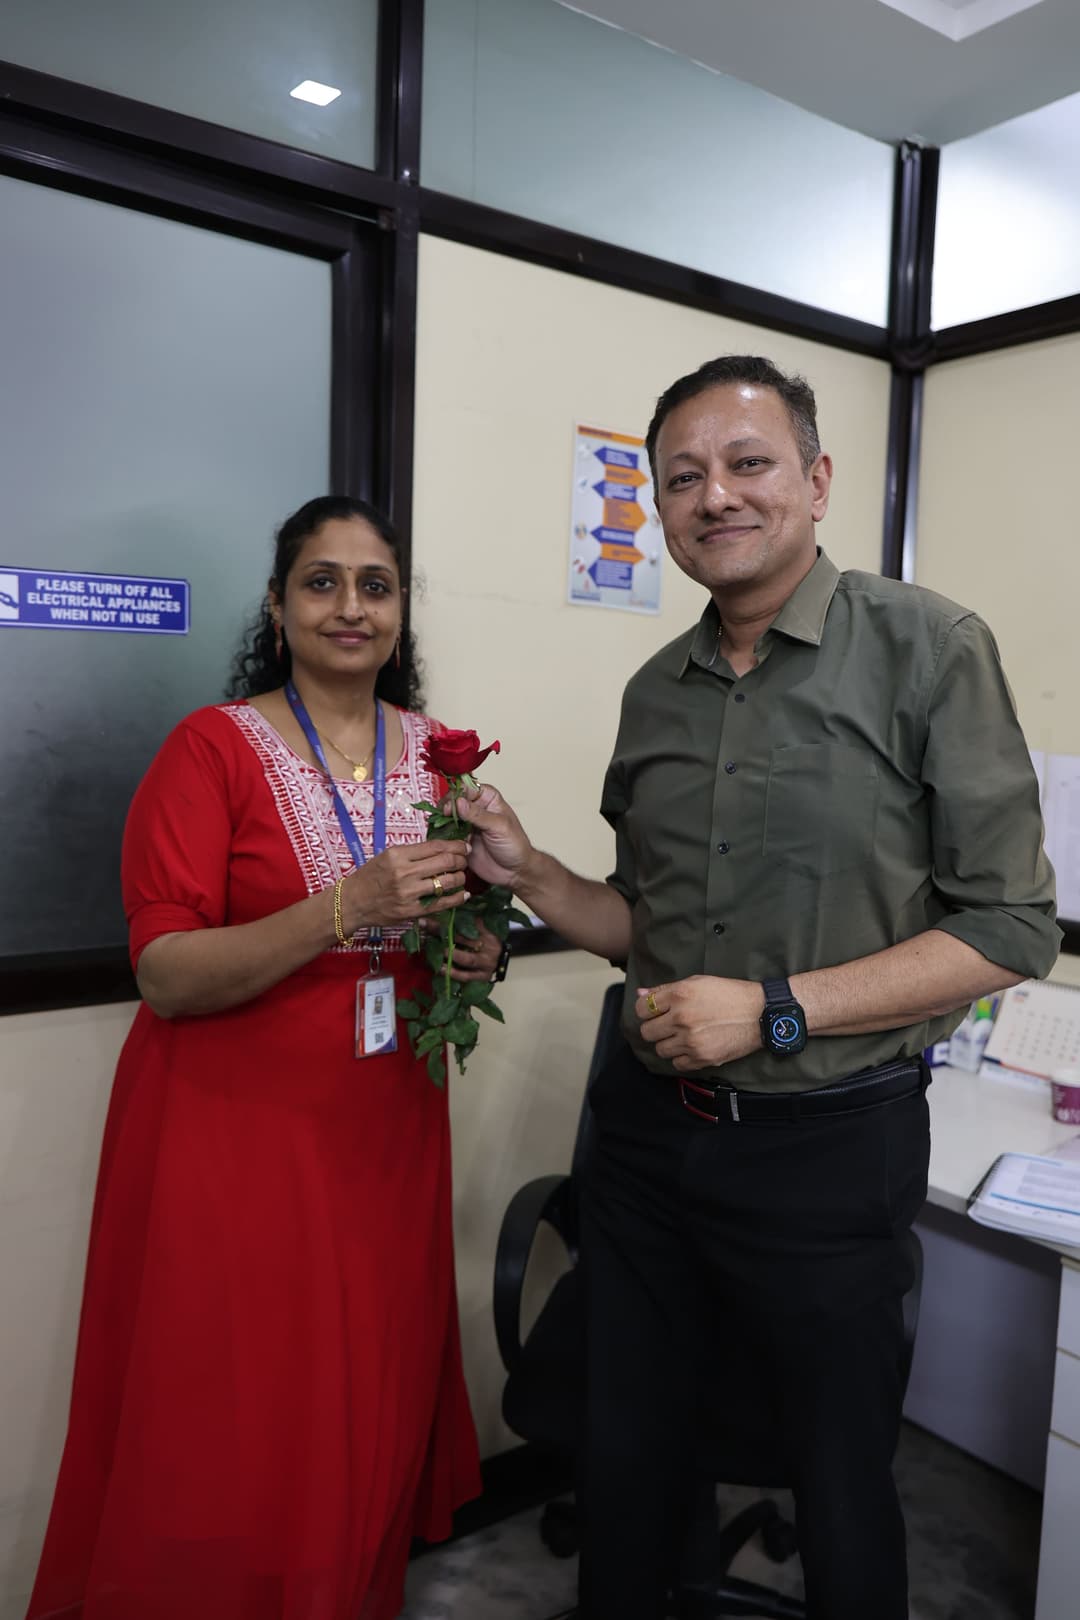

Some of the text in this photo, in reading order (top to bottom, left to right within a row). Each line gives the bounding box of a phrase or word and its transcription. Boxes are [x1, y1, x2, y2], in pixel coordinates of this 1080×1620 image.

[36, 579, 172, 599] PLEASE TURN OFF ALL
[27, 592, 181, 613] ELECTRICAL APPLIANCES
[51, 608, 160, 625] WHEN NOT IN USE
